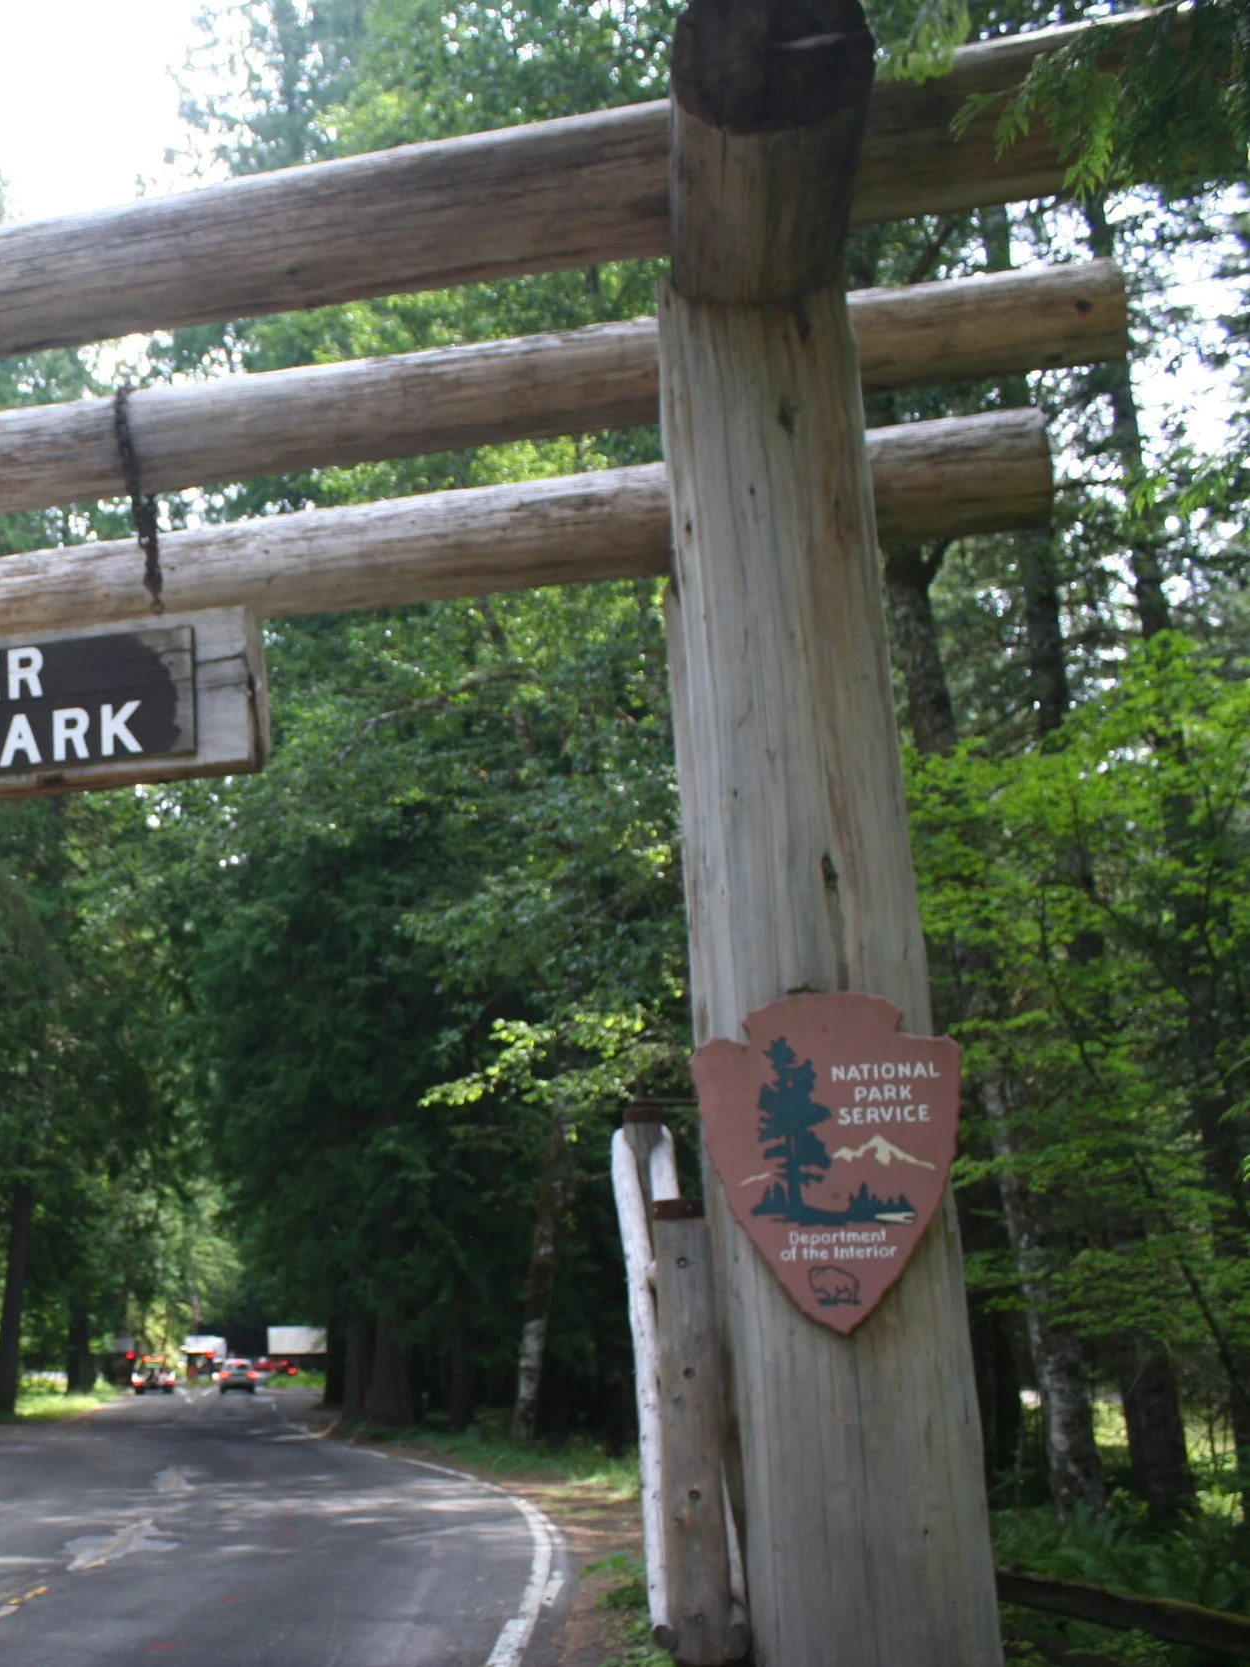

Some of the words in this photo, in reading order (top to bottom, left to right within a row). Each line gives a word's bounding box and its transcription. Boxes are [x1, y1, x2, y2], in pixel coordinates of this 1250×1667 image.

[831, 1062, 940, 1082] NATIONAL
[854, 1085, 912, 1102] PARK
[838, 1105, 930, 1125] SERVICE
[788, 1229, 887, 1245] Department
[780, 1246, 797, 1262] of
[803, 1246, 829, 1260] the
[833, 1244, 897, 1260] Interior
